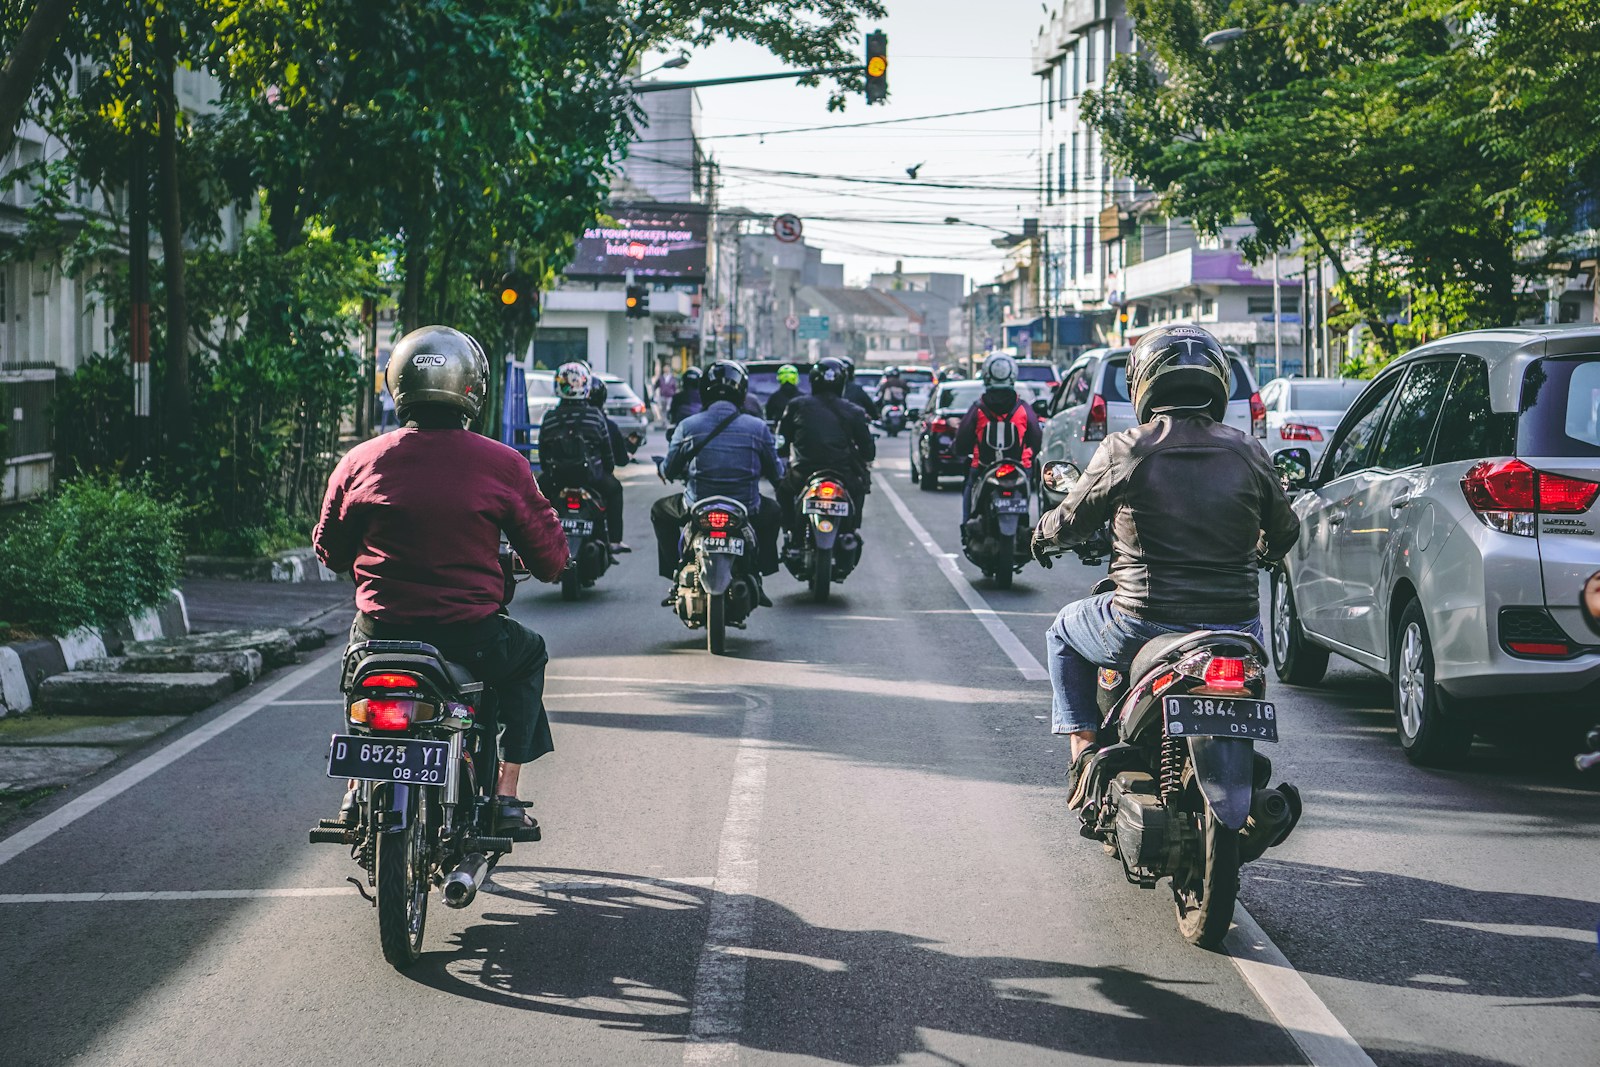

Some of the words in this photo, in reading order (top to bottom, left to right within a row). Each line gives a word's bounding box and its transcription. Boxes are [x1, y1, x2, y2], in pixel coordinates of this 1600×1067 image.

[602, 229, 628, 239] YOUR
[630, 230, 666, 241] TICKETS
[667, 231, 692, 241] NOW
[1169, 699, 1180, 716] D
[336, 742, 347, 760] D
[360, 743, 407, 764] 6525
[422, 746, 443, 766] YI
